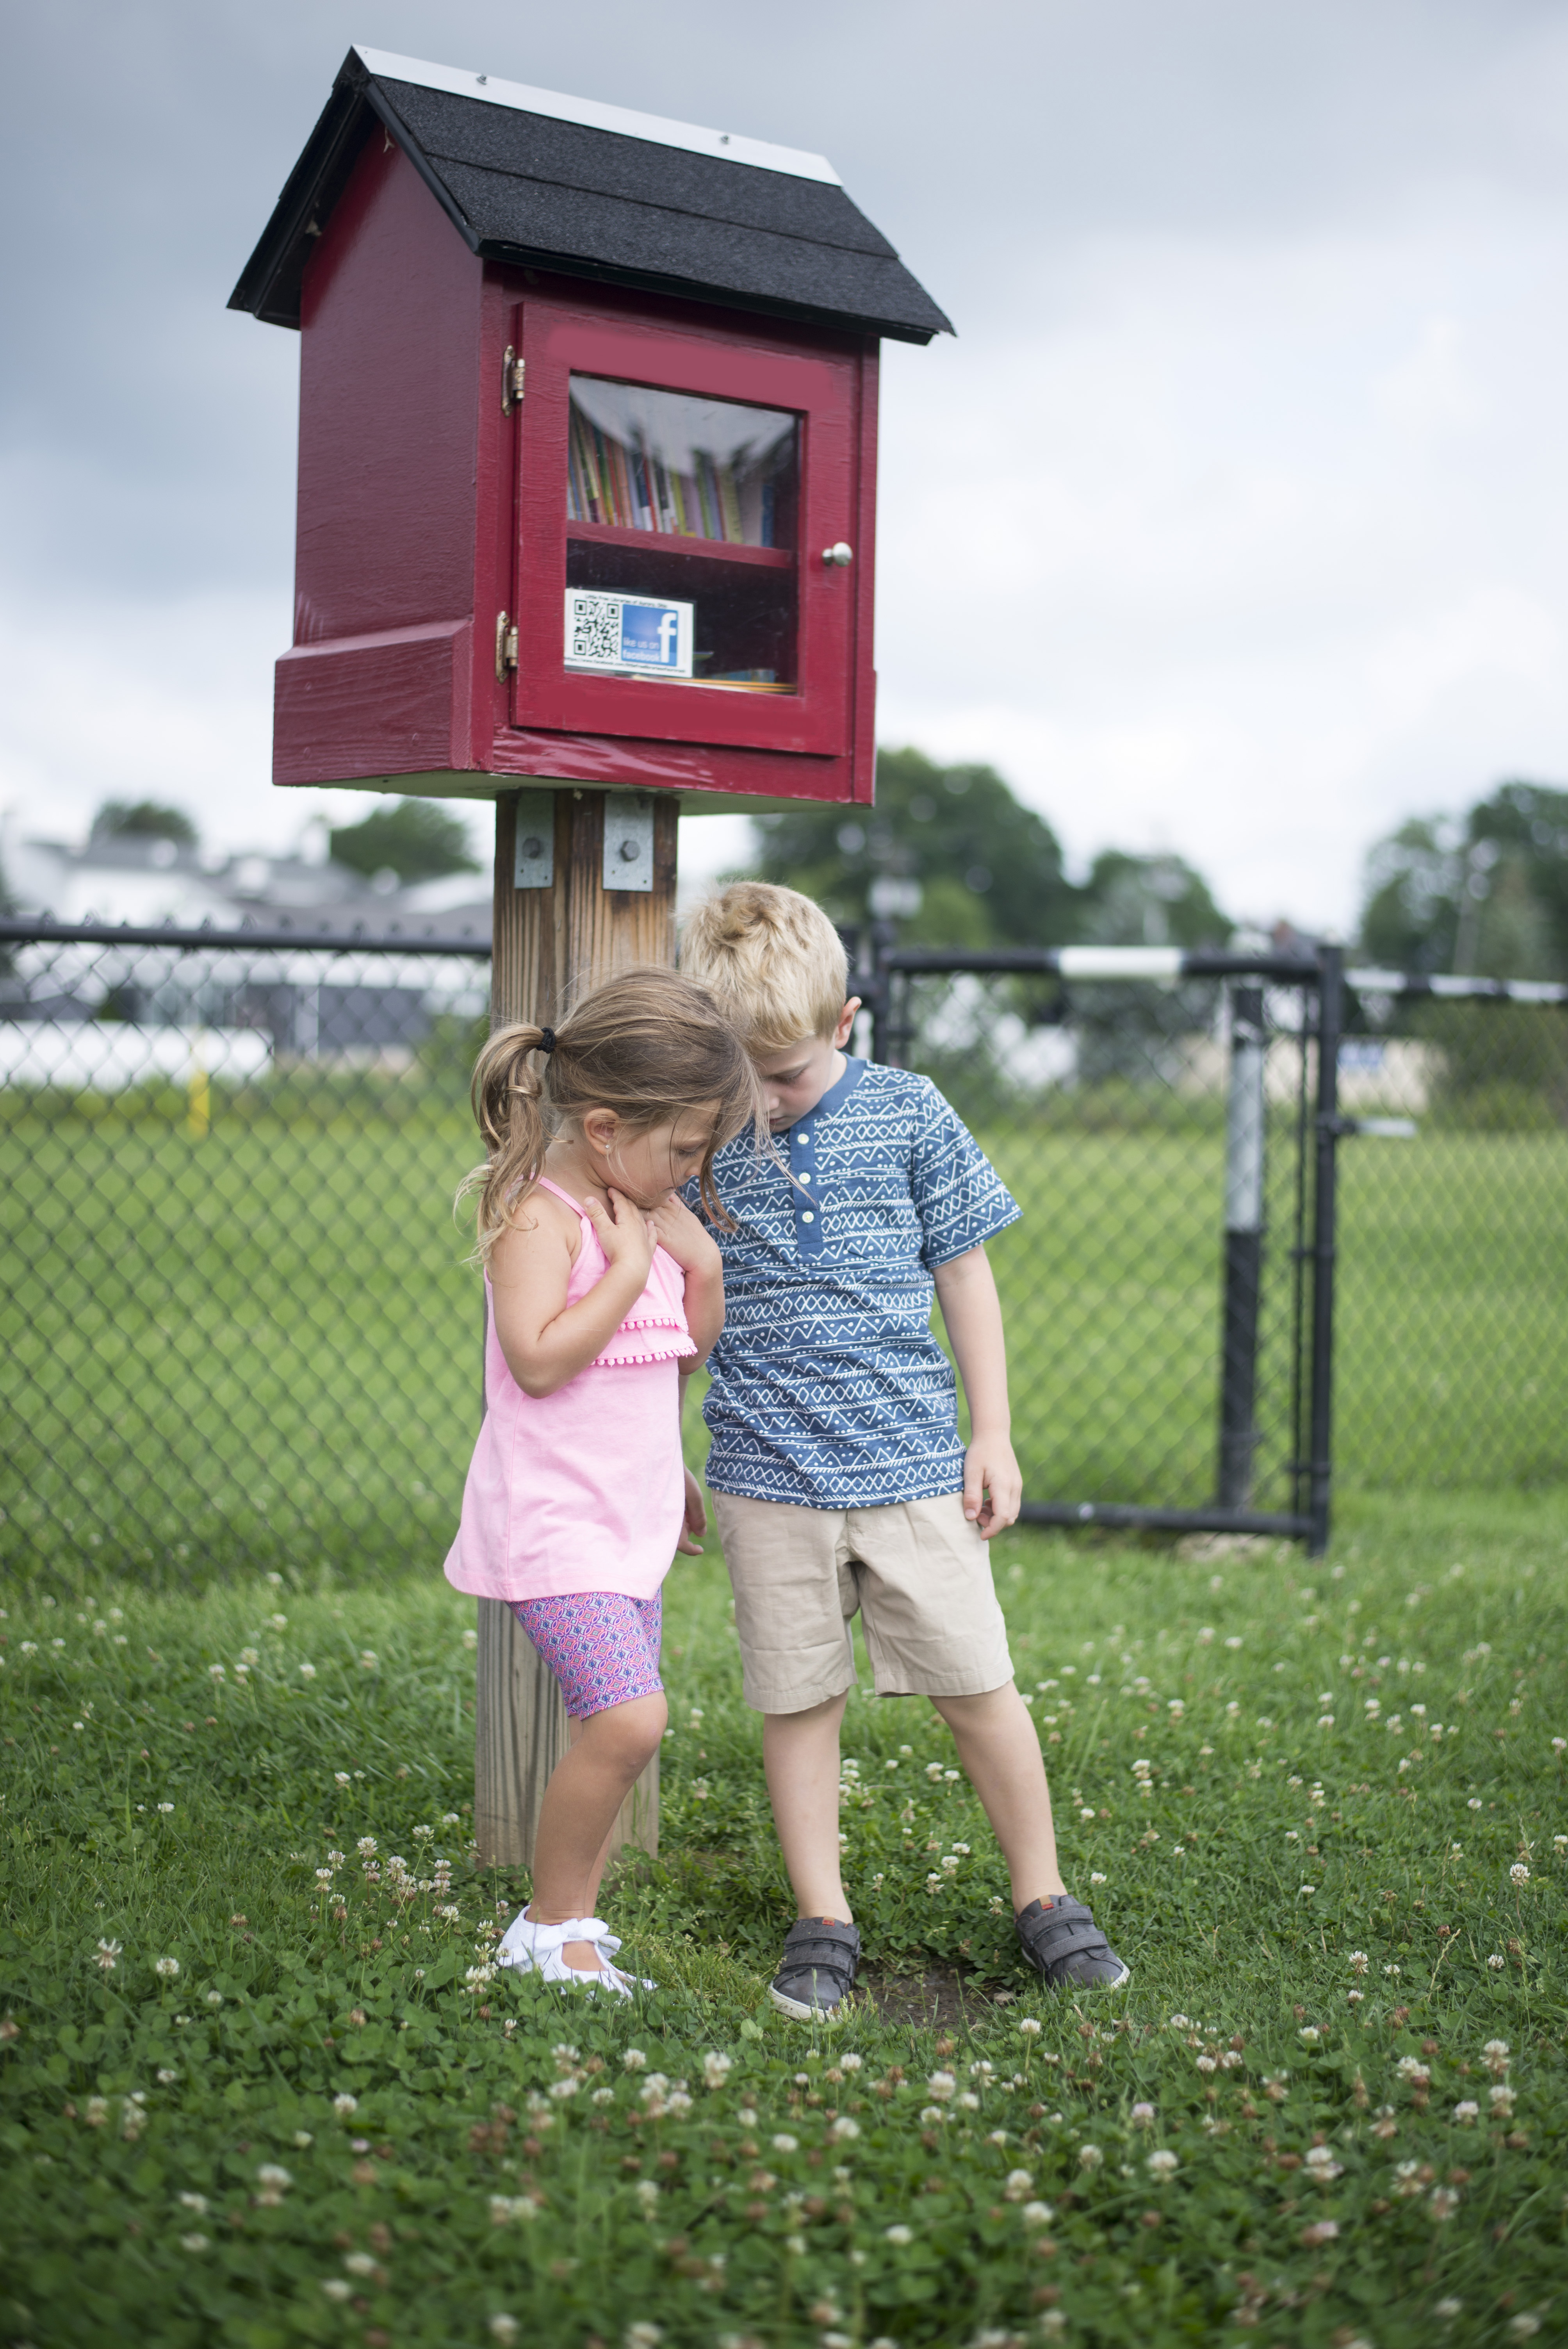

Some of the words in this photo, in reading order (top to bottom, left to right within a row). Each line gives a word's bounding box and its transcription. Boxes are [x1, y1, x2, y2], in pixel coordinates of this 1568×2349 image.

[623, 636, 636, 647] like
[657, 612, 677, 663] f
[623, 649, 660, 662] facebook
